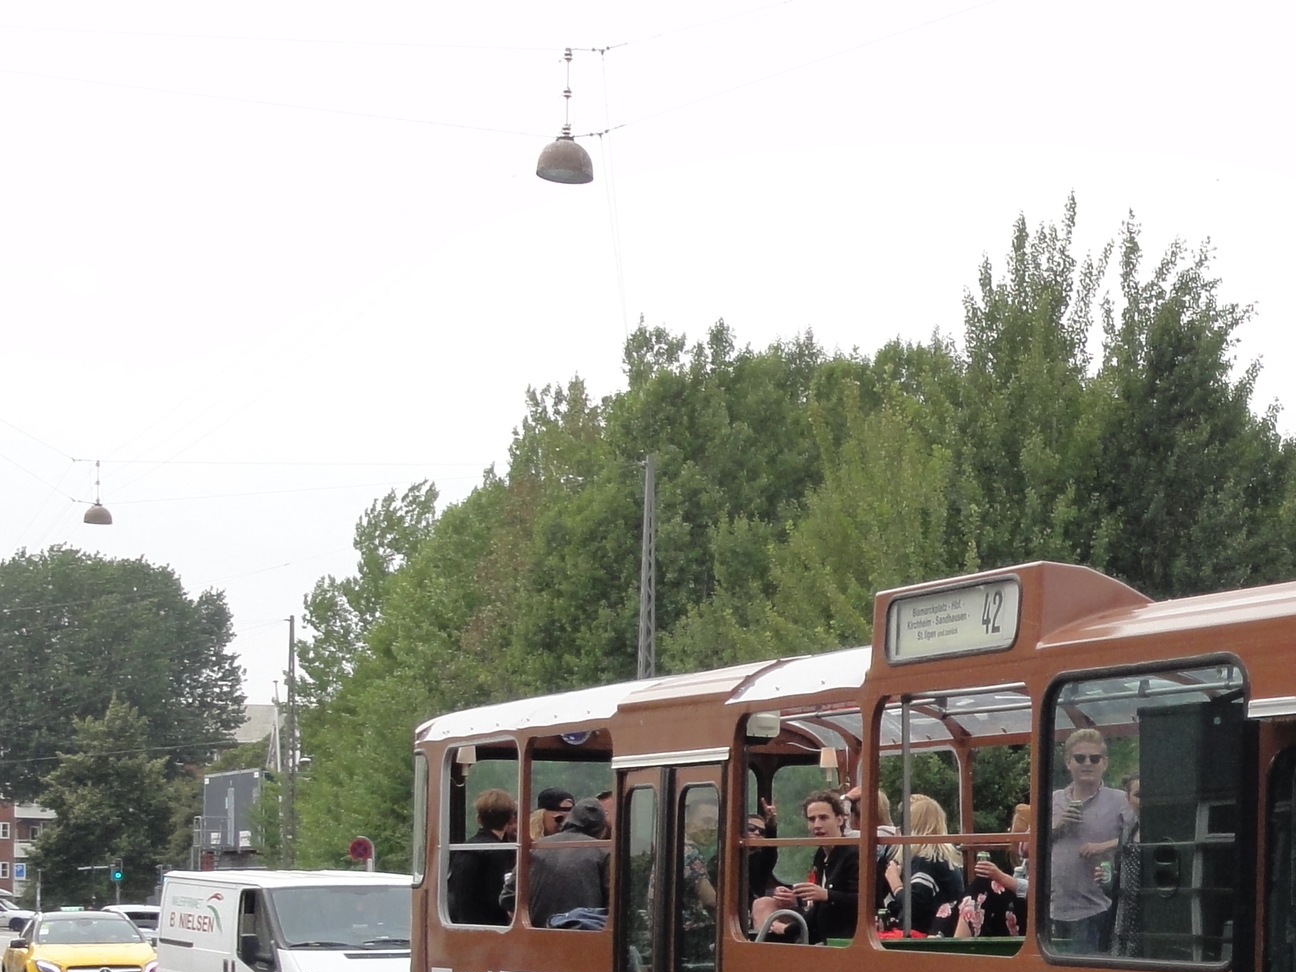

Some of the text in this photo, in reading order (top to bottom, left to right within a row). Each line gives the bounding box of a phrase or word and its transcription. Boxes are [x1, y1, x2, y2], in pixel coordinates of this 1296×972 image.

[907, 613, 967, 631] Kirchheim Sandhausen
[981, 590, 1003, 634] 42
[179, 913, 214, 933] NIELSEN
